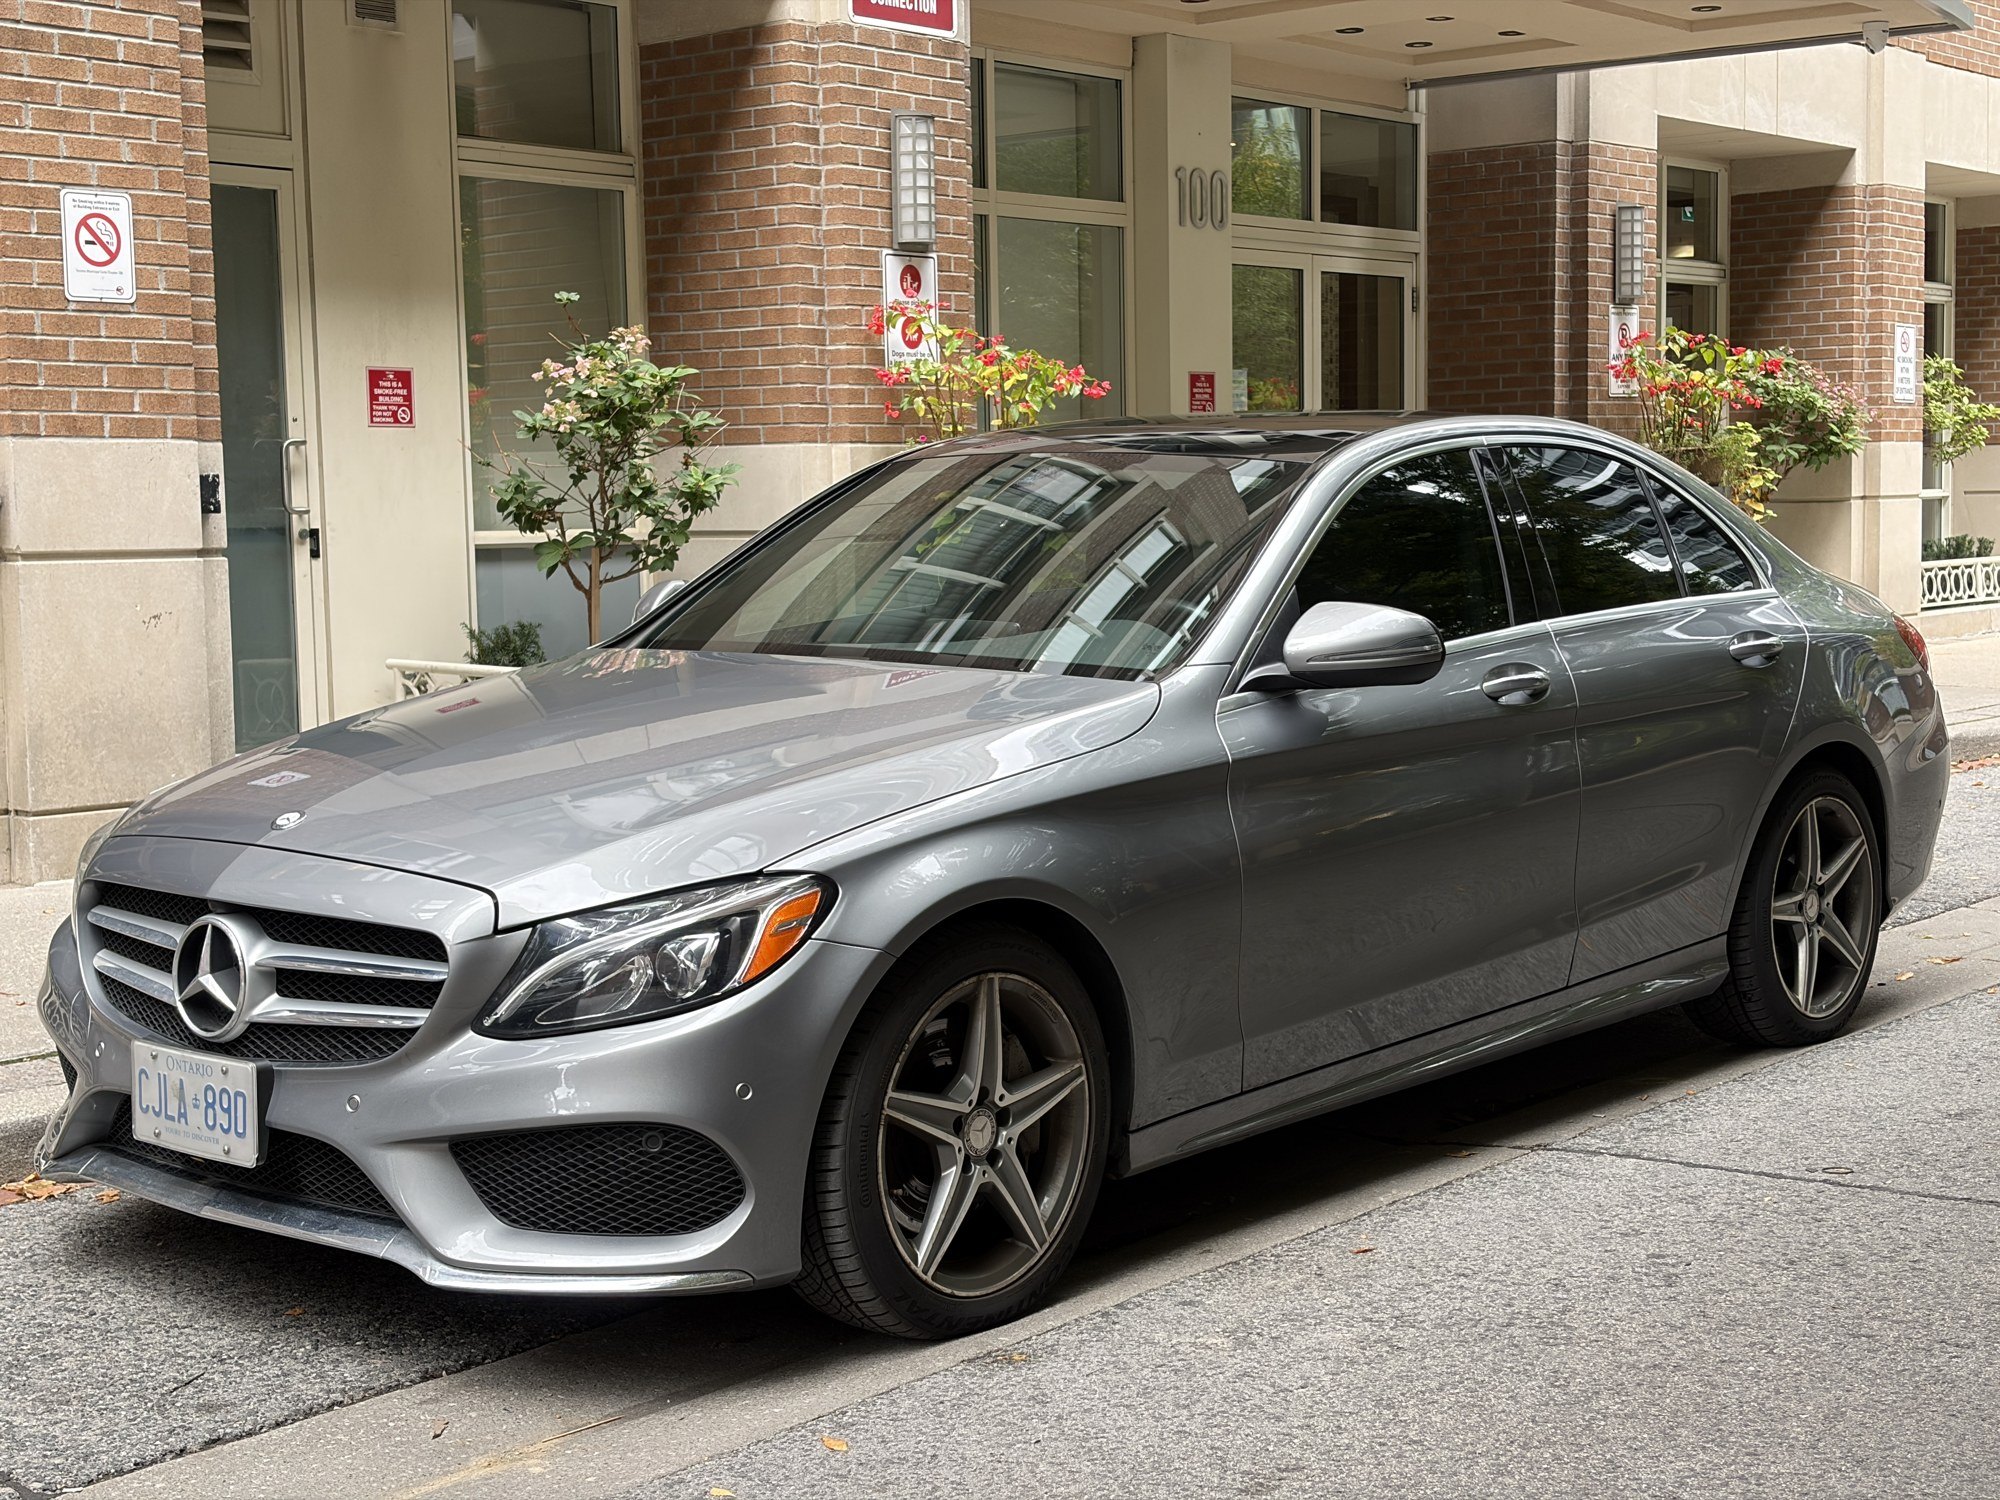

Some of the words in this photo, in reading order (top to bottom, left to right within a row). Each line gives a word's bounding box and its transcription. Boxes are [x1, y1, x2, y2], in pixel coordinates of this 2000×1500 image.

[1175, 166, 1228, 231] 100
[892, 350, 905, 358] Dogs
[1612, 353, 1623, 361] ANY
[374, 388, 407, 396] SMOKE-FREE
[166, 1055, 214, 1078] ONTARIO
[138, 1067, 189, 1126] CJLA
[203, 1084, 247, 1139] 890
[165, 1127, 181, 1136] YOURS
[183, 1130, 190, 1138] TO
[192, 1132, 220, 1145] DISCOVER
[857, 1124, 872, 1208] Continental
